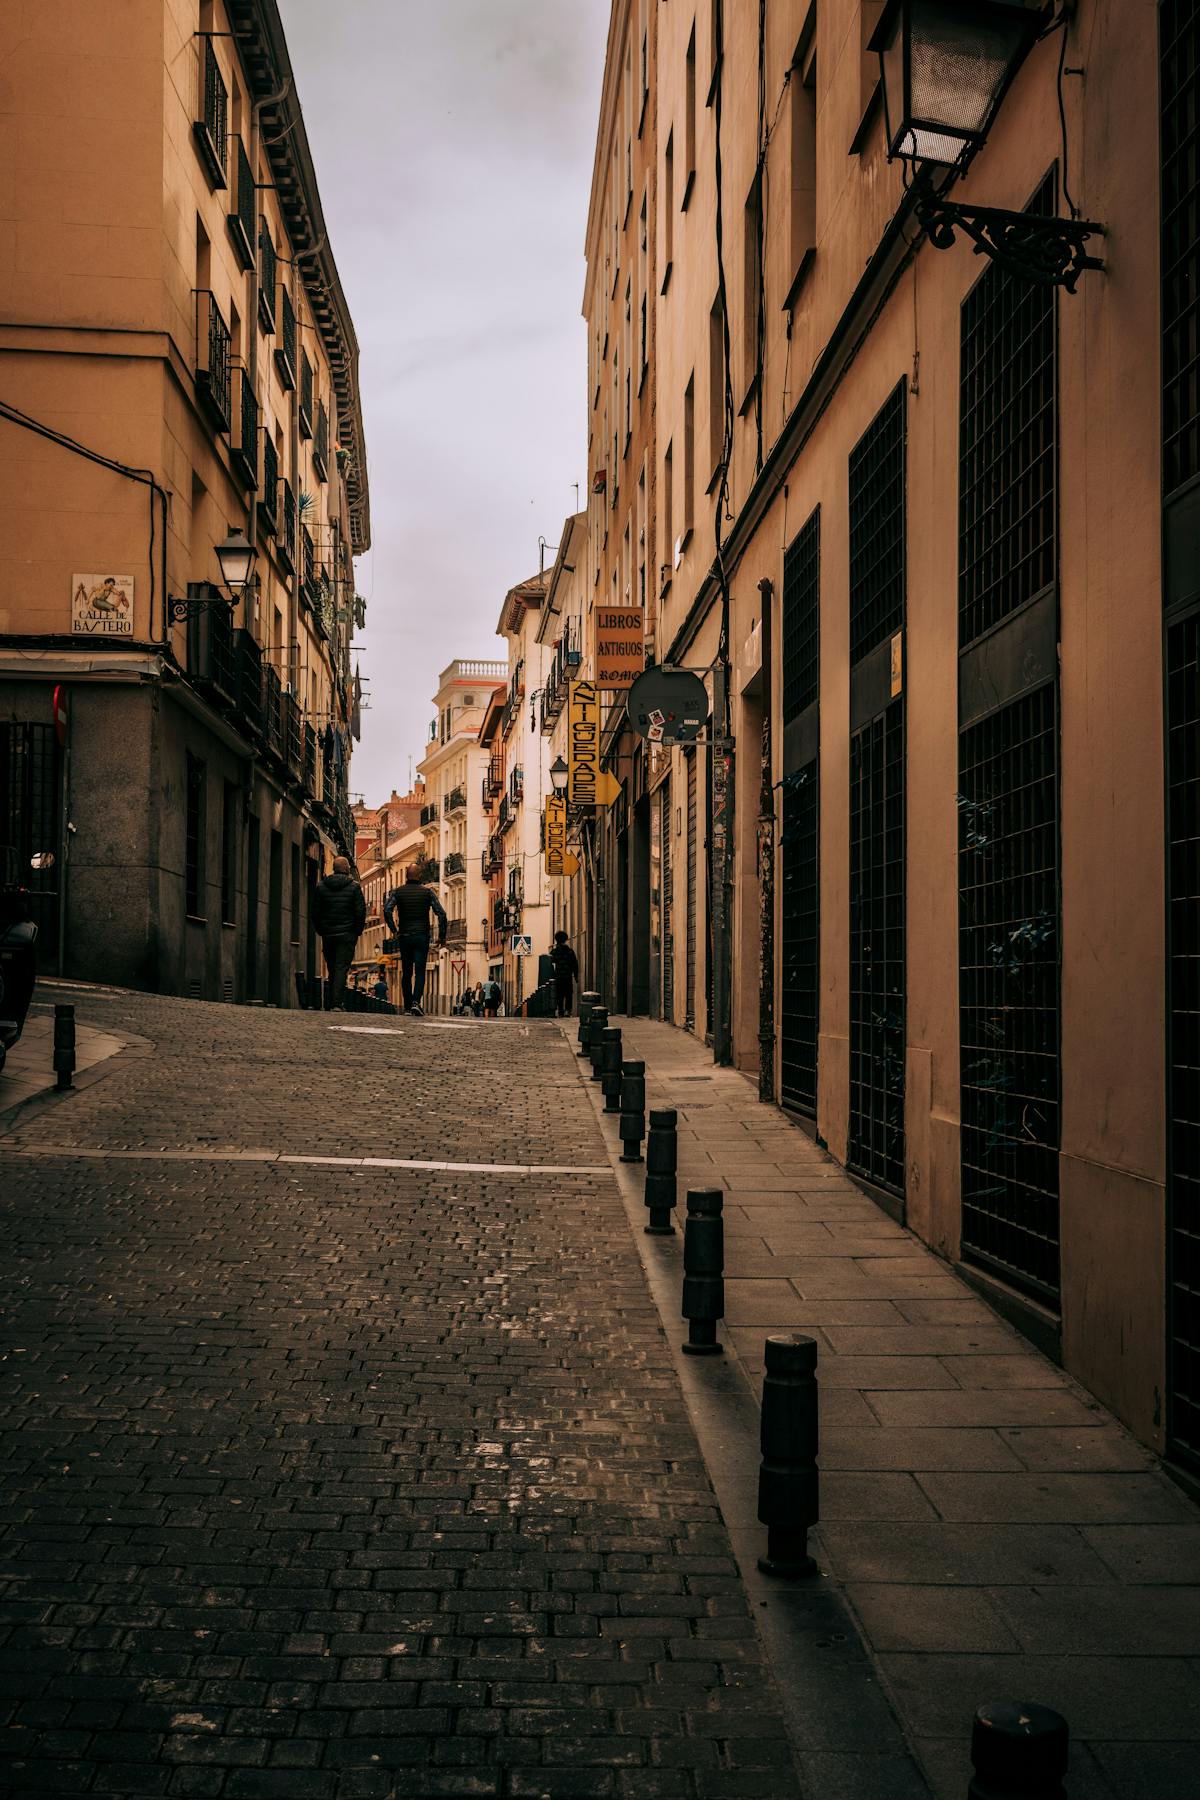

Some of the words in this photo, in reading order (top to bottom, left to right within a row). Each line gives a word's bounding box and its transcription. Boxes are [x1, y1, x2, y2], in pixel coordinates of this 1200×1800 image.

[79, 610, 112, 620] CALLE
[116, 612, 127, 620] DE
[598, 614, 641, 629] LIBROS
[74, 620, 131, 633] BASTERO
[597, 641, 643, 656] ANTIGUOS
[599, 670, 641, 682] ROMO
